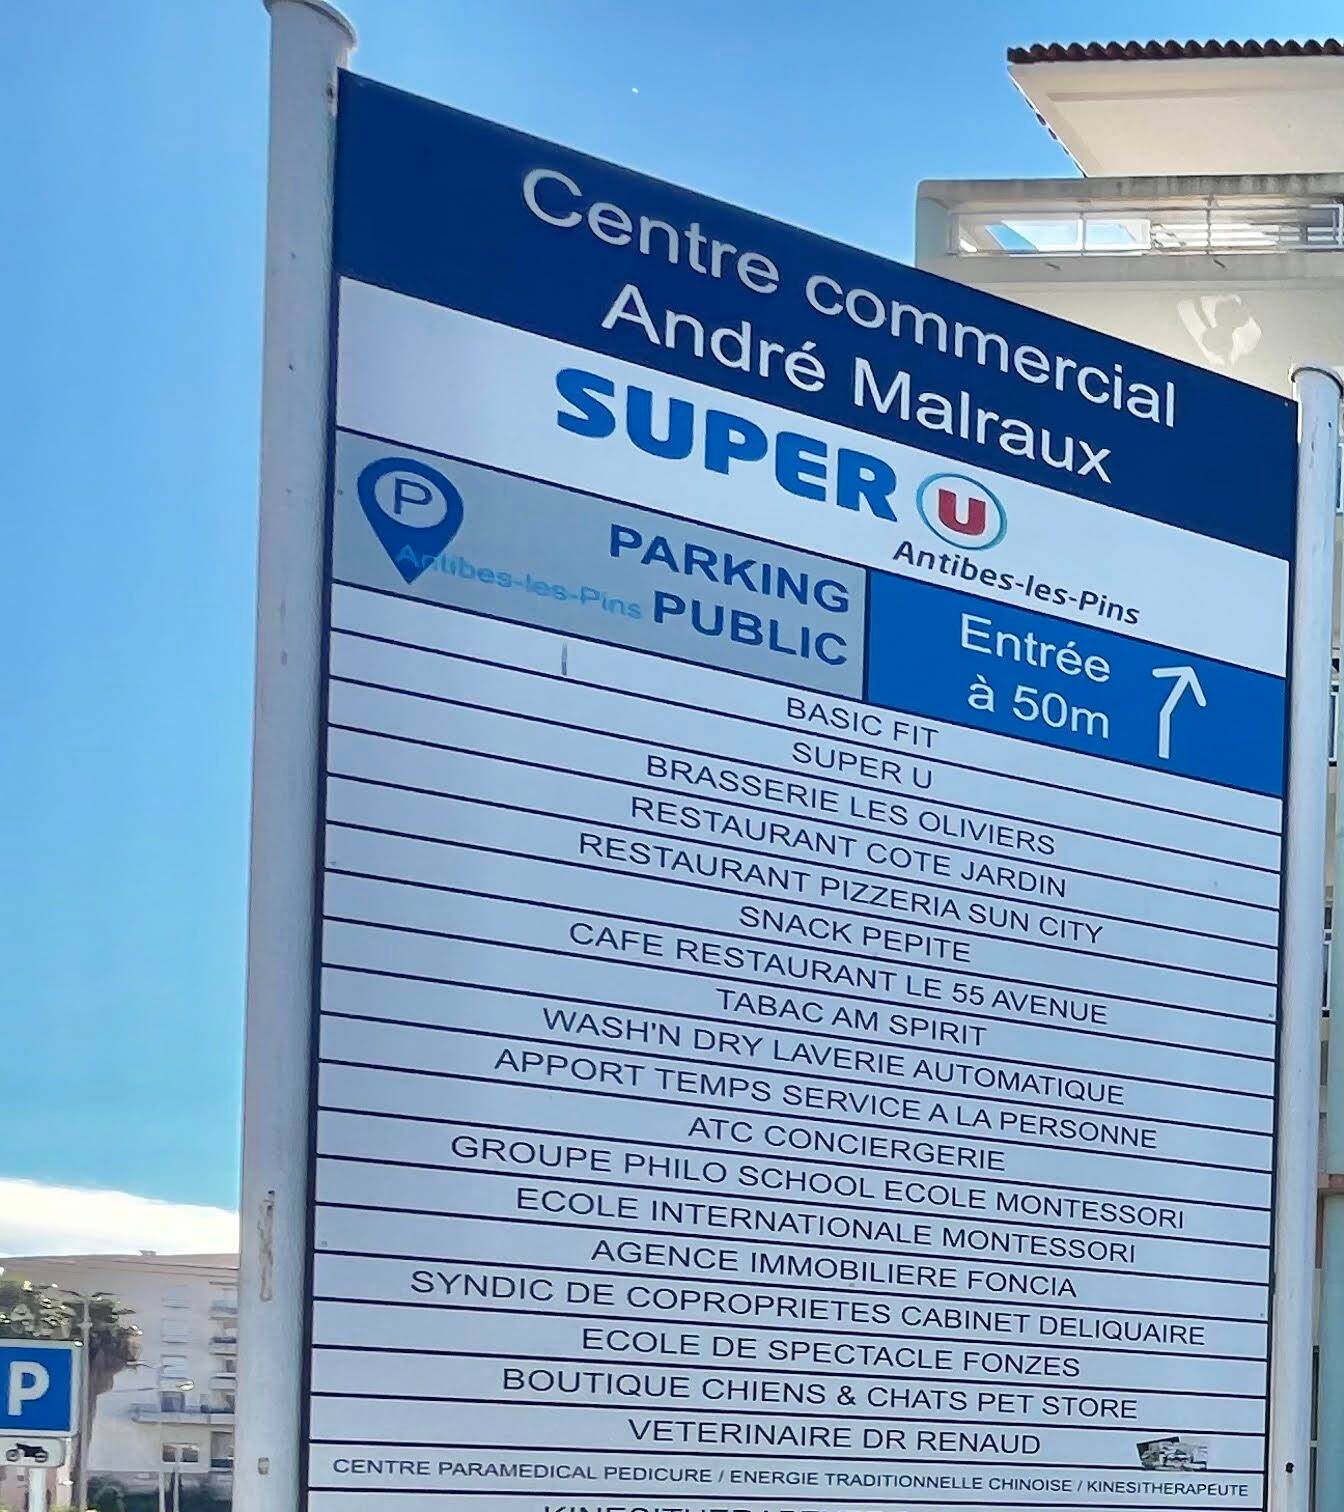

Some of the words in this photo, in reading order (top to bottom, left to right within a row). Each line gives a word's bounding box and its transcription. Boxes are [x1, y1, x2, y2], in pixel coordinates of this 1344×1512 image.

[523, 170, 780, 293] Centre
[806, 273, 1176, 428] commercial
[600, 284, 828, 392] André
[851, 357, 1114, 484] Malraux
[553, 366, 899, 524] SUPER
[394, 478, 432, 515] P
[934, 488, 987, 537] U
[610, 524, 850, 615] PARKING
[891, 539, 1140, 626] Antibes-les-Pins
[652, 591, 849, 667] PUBLIC
[958, 612, 1112, 684] Entrée
[787, 696, 882, 736] BASIC
[893, 720, 939, 748] FIT
[967, 674, 996, 714] à
[1010, 683, 1111, 739] 50m
[792, 742, 901, 784] SUPER
[913, 766, 931, 789] U
[647, 754, 839, 813] BRASSERIE
[850, 796, 907, 826] LES
[918, 811, 1054, 855] OLIVIERS
[632, 796, 857, 858] RESTAURANT
[866, 843, 950, 877] COTE
[960, 861, 1065, 897] JARDIN
[580, 832, 811, 892] RESTAURANT
[821, 876, 961, 920] PIZZERIA
[968, 903, 1028, 932] SUN
[1039, 916, 1103, 943] CITY
[739, 905, 852, 944] SNACK
[863, 926, 970, 963] PEPITE
[569, 922, 663, 957] CAFE
[676, 938, 897, 991] RESTAURANT
[907, 975, 942, 999] LE
[952, 982, 984, 1005] 55
[991, 989, 1107, 1025] AVENUE
[715, 988, 823, 1023] TABAC
[831, 1006, 878, 1032] AM
[889, 1014, 987, 1046] SPIRIT
[543, 1007, 680, 1047] WASH'N
[694, 1028, 763, 1056] DRY
[773, 1039, 904, 1076] LAVERIE
[912, 1059, 1124, 1105] AUTOMATIQUE
[494, 1048, 645, 1086] APPORT
[654, 1067, 771, 1102] TEMPS
[782, 1084, 920, 1120] SERVICE
[928, 1103, 948, 1124] A
[957, 1105, 992, 1129] LA
[1000, 1111, 1157, 1149] PERSONNE
[688, 1116, 752, 1143] ATC
[764, 1125, 1004, 1171] CONCIERGERIE
[451, 1135, 611, 1172] GROUPE
[625, 1153, 727, 1183] PHILO
[738, 1165, 875, 1198] SCHOOL
[884, 1180, 986, 1209] ECOLE
[996, 1191, 1183, 1229] MONTESSORI
[517, 1187, 639, 1219] ECOLE
[652, 1200, 931, 1245] INTERNATIONALE
[942, 1227, 1134, 1263] MONTESSORI
[591, 1240, 738, 1271] AGENCE
[751, 1252, 957, 1288] IMMOBILIERE
[968, 1270, 1076, 1297] FONCIA
[410, 1270, 554, 1301] SYNDIC
[566, 1281, 615, 1305] DE
[626, 1286, 890, 1324] COPROPRIETES
[901, 1306, 1031, 1333] CABINET
[1039, 1315, 1205, 1345] DELIQUAIRE
[8, 1361, 49, 1417] P
[583, 1328, 700, 1355] ECOLE
[712, 1336, 757, 1359] DE
[768, 1339, 953, 1370] SPECTACLE
[963, 1351, 1079, 1377] FONZES
[503, 1368, 690, 1398] BOUTIQUE
[702, 1378, 825, 1404] CHIENS
[867, 1386, 967, 1410] CHATS
[978, 1392, 1034, 1413] PET
[1042, 1395, 1137, 1419] STORE
[627, 1419, 851, 1448] VETERINAIRE
[863, 1428, 906, 1450] DR
[917, 1430, 1040, 1454] RENAUD
[333, 1459, 431, 1475] CENTRE
[438, 1462, 598, 1479] PARAMEDICAL
[604, 1466, 712, 1482] PEDICURE
[730, 1470, 819, 1485] ENERGIE
[824, 1473, 983, 1489] TRADITIONNELLE
[988, 1477, 1072, 1492] CHINOISE
[1087, 1480, 1248, 1496] KINESITHERAPEUTE
